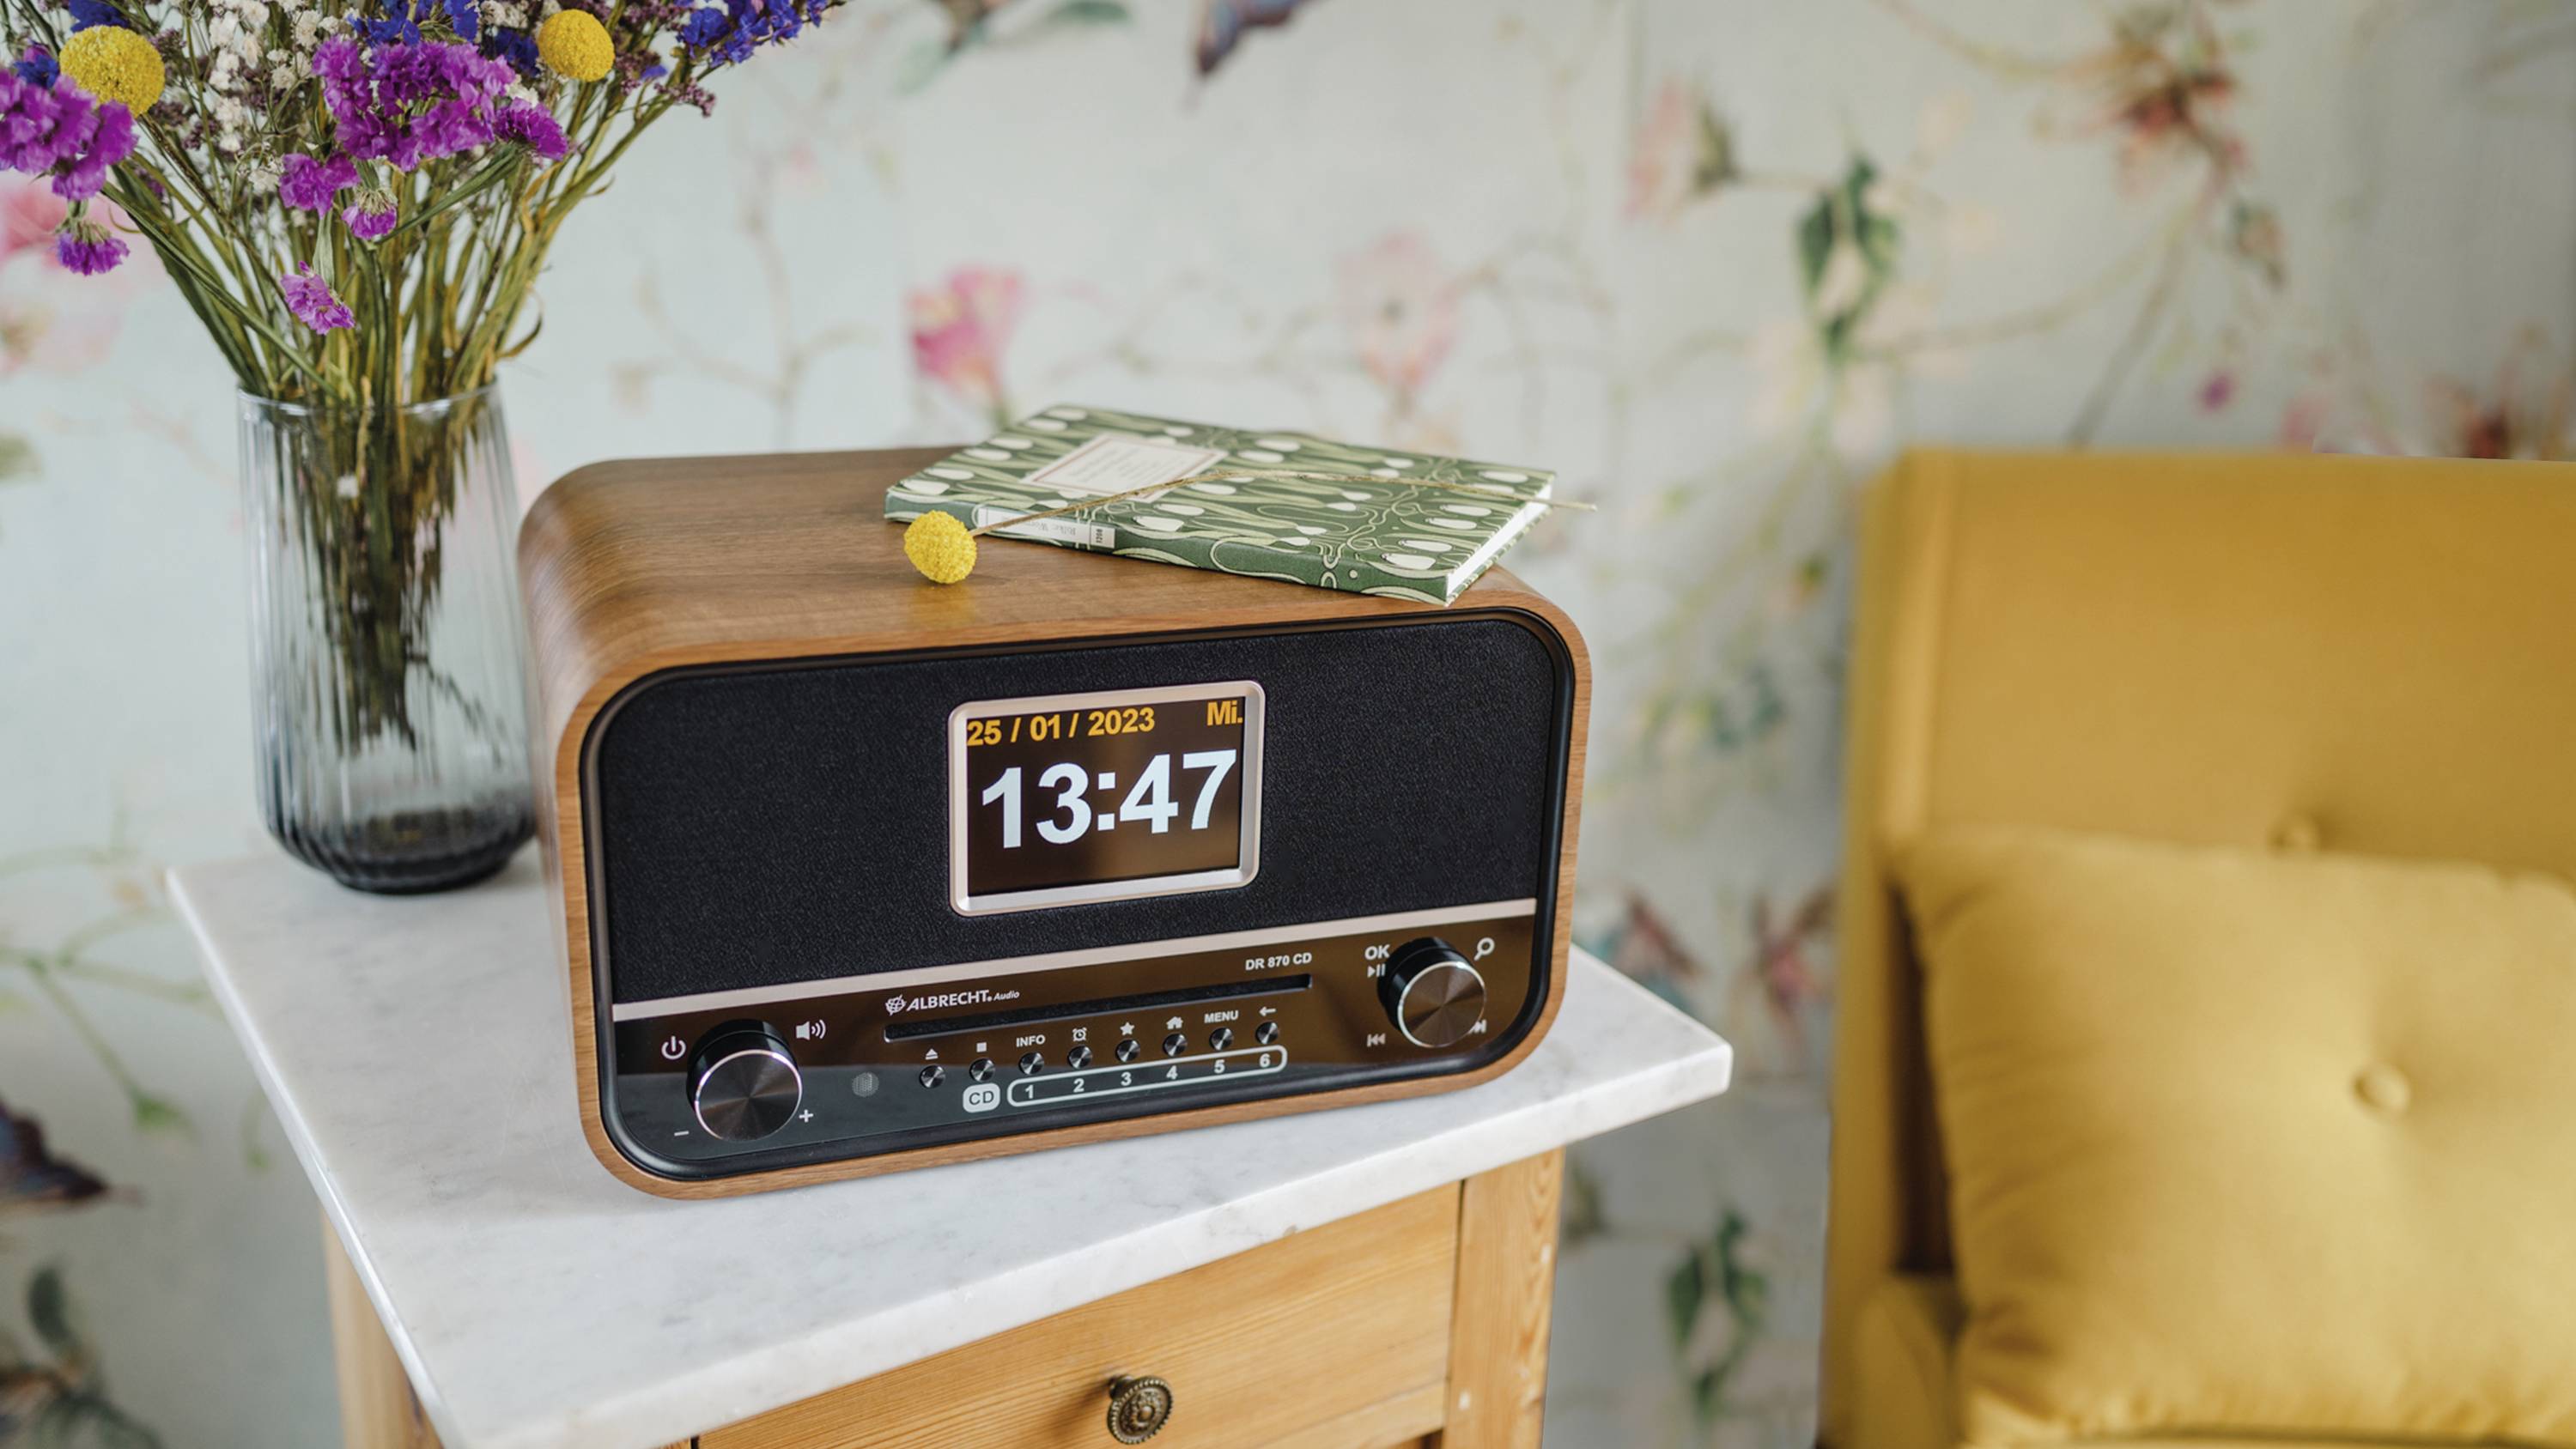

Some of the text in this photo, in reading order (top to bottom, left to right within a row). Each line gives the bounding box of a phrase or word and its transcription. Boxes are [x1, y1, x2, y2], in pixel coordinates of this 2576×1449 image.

[1206, 700, 1243, 726] Mi.
[967, 719, 1002, 746] 25
[1030, 714, 1060, 742] 01
[1088, 707, 1155, 737] 2023
[982, 749, 1237, 849] 13:47
[1245, 952, 1312, 971] DR 870 CD
[1364, 944, 1390, 961] OK
[993, 991, 1020, 1002] Audio
[1205, 1010, 1239, 1023] MENU
[1017, 1034, 1046, 1047] INFO
[1024, 1053, 1270, 1099] 1 2 3 4 5 6
[969, 1090, 994, 1105] CD
